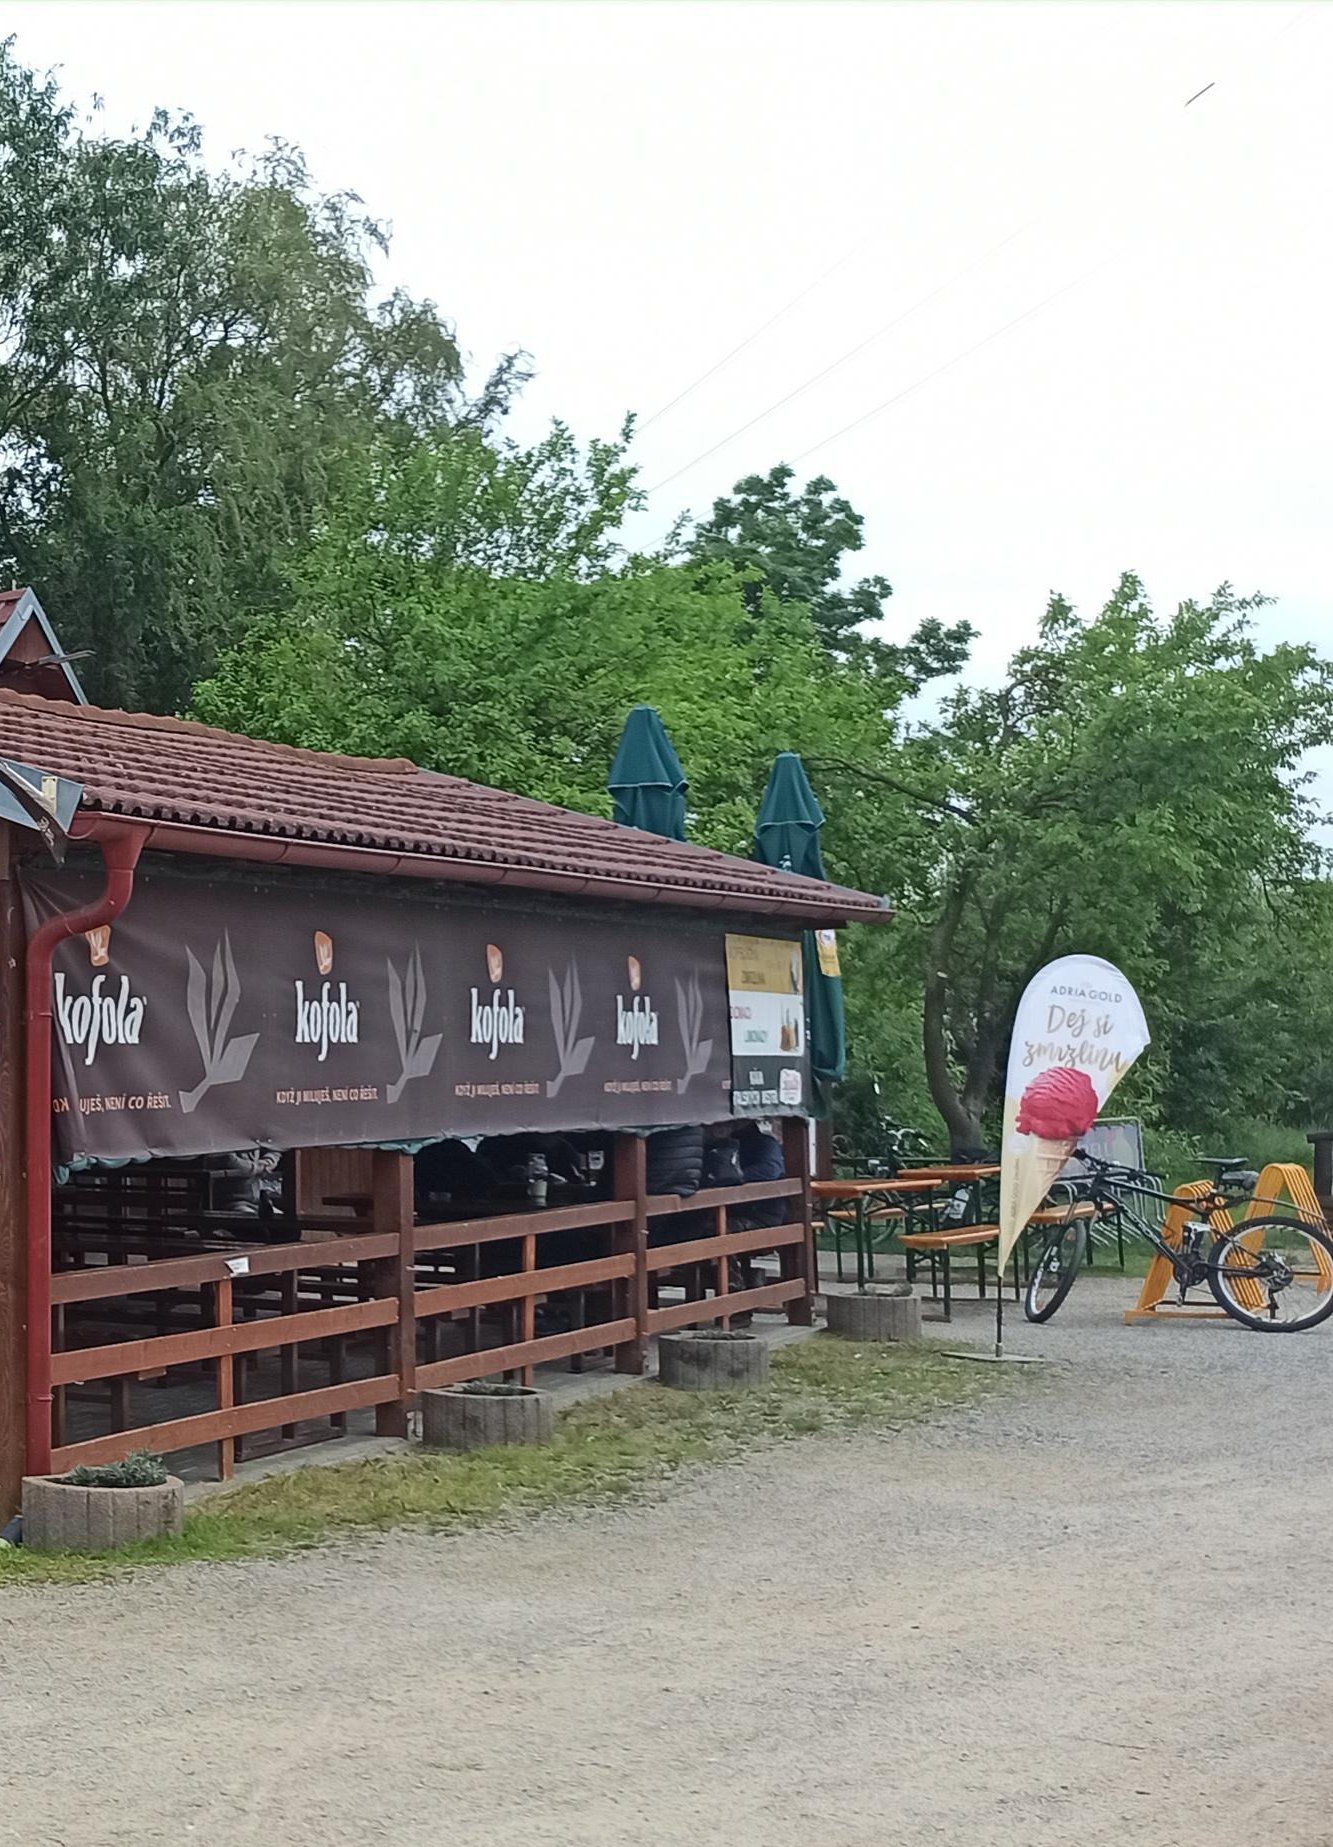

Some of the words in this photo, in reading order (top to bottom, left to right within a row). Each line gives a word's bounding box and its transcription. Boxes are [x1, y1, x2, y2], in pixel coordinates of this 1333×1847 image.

[54, 972, 144, 1066] kofola
[295, 980, 359, 1061] kofola
[470, 987, 525, 1061] kofola
[615, 994, 659, 1061] kofola
[1047, 1004, 1088, 1038] Dej
[1093, 1014, 1113, 1038] si
[1050, 986, 1086, 998] ADRIA
[1089, 990, 1123, 1003] GOLD
[128, 1096, 144, 1109] CO
